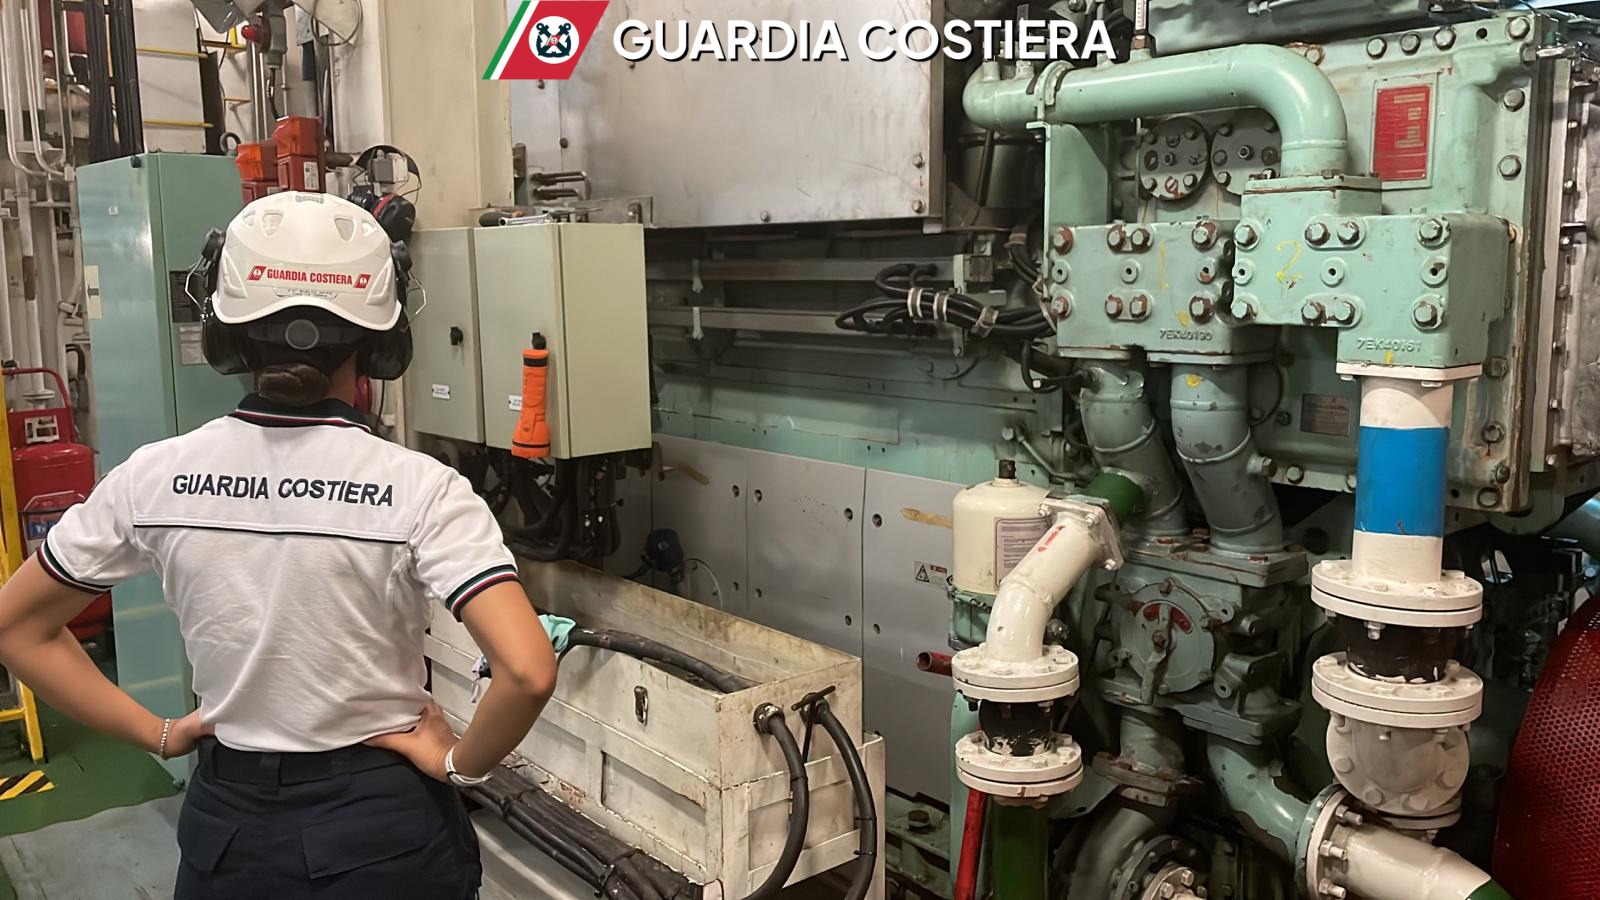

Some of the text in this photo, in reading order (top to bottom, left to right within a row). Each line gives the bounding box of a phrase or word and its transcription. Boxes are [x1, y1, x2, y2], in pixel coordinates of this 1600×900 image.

[267, 269, 353, 285] GUARDIA COSTIERA
[1275, 239, 1304, 283] 2
[172, 474, 393, 506] GUARDIA COSTIERA
